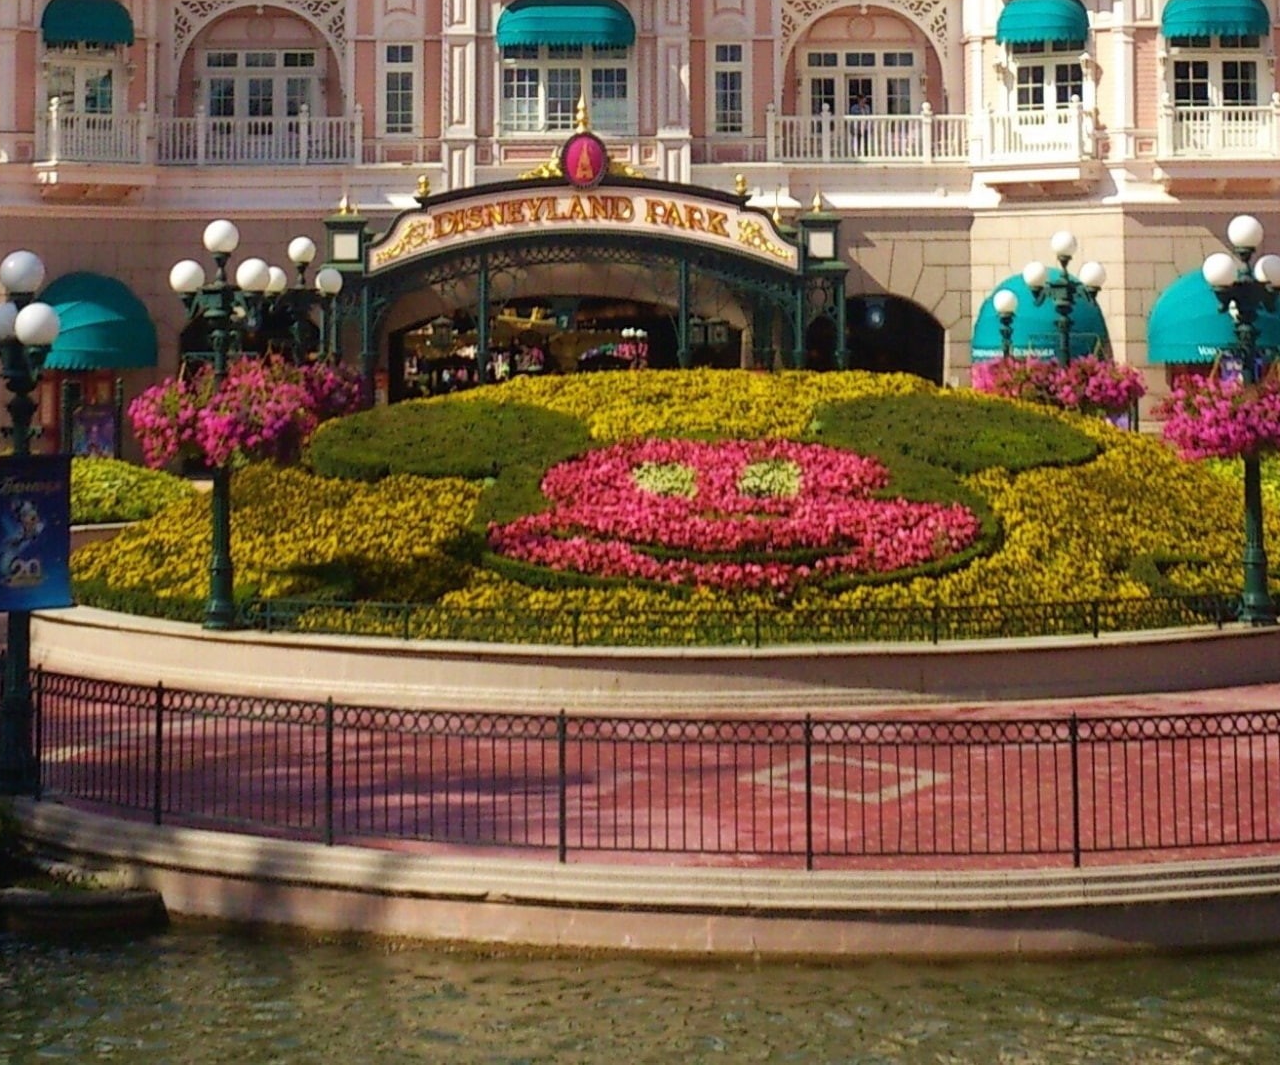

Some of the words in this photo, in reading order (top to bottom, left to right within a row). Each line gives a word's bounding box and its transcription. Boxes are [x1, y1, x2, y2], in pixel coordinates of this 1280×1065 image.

[431, 195, 635, 236] DISNEYLAND
[645, 199, 730, 236] PARK
[11, 558, 40, 578] 20
